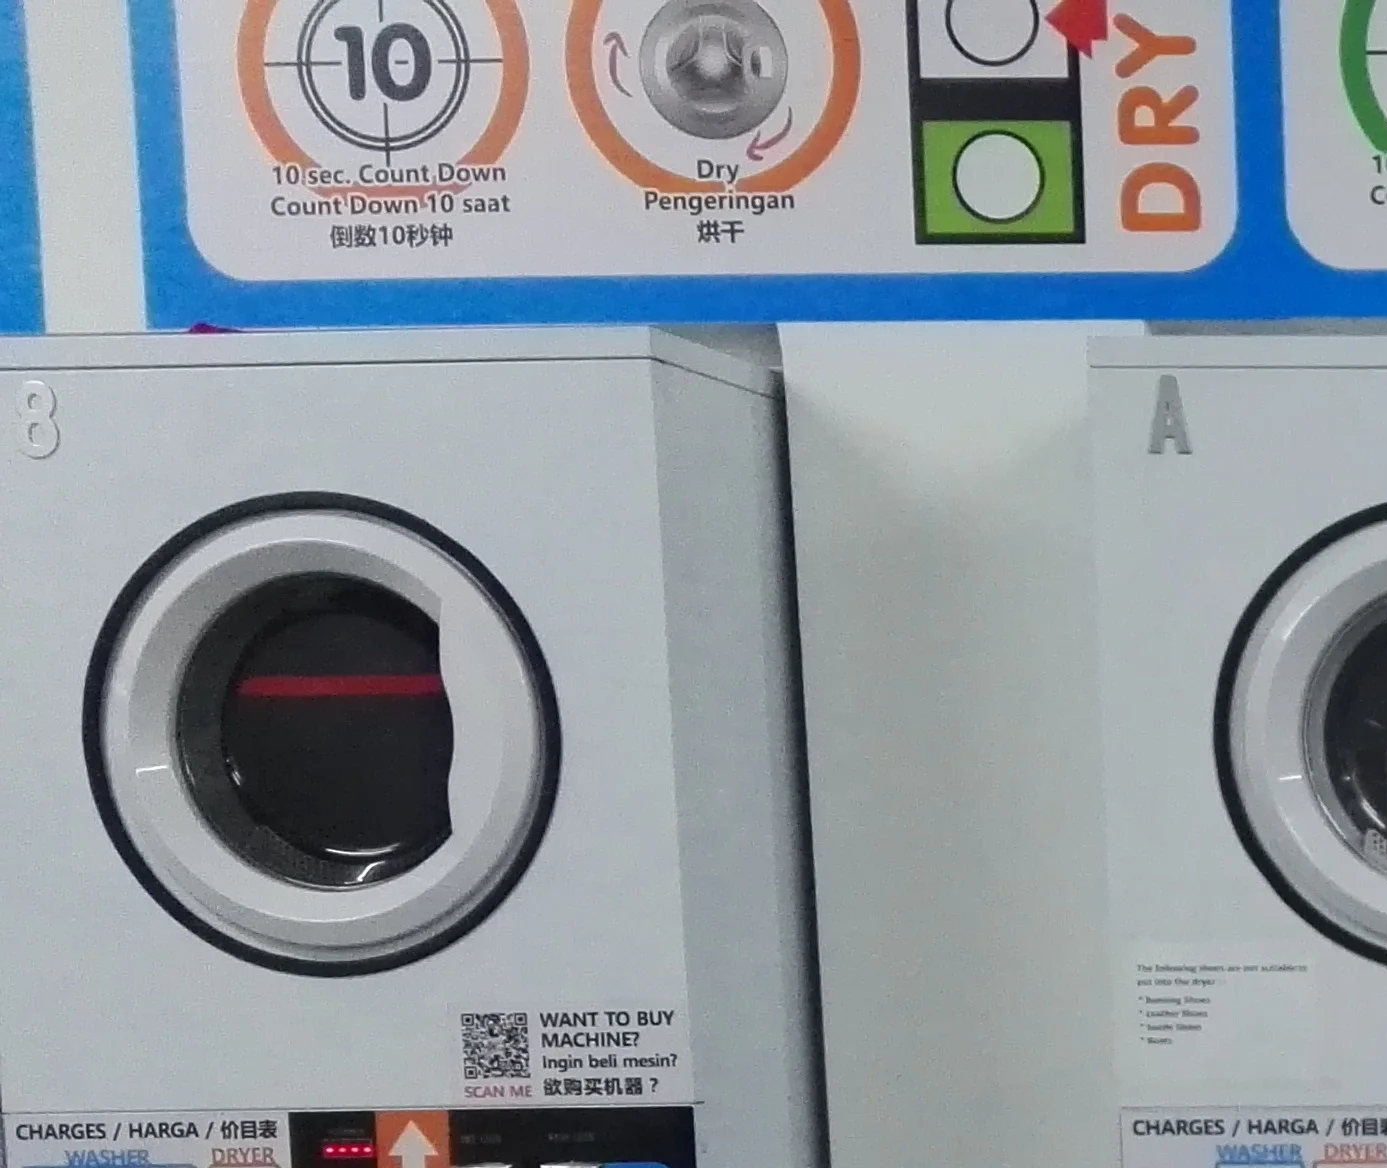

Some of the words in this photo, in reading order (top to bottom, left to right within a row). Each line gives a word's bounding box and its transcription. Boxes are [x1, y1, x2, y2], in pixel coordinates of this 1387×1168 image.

[334, 23, 432, 102] 10
[1112, 12, 1200, 232] DRY
[272, 165, 299, 186] 10
[308, 164, 352, 186] sec.
[358, 162, 430, 184] Count
[438, 161, 507, 183] Down
[697, 158, 739, 183] Dry
[271, 194, 342, 216] Count
[349, 194, 418, 215] Down
[426, 194, 455, 214] 10
[462, 193, 511, 214] saat
[644, 190, 796, 213] Pengeringan
[329, 224, 453, 249] 倒数10秒钟
[697, 219, 745, 244] 烘干
[17, 379, 60, 459] 8
[1147, 374, 1193, 455] A
[540, 1012, 598, 1027] WANT
[605, 1011, 630, 1026] TO
[637, 1010, 674, 1026] BUY
[541, 1033, 640, 1048] MACHINE?
[542, 1054, 583, 1071] Ingin
[588, 1053, 618, 1069] beli
[623, 1053, 678, 1069] mesin?
[464, 1086, 505, 1098] SCAN
[16, 1123, 106, 1140] CHARGES
[113, 1122, 122, 1141] /
[128, 1121, 199, 1139] HARGA
[205, 1121, 214, 1140] /
[220, 1119, 278, 1140] 价目表
[1132, 1118, 1225, 1136] CHARGES
[1231, 1119, 1240, 1138] /
[1247, 1118, 1319, 1136] HARGA
[1326, 1118, 1334, 1137] /
[65, 1149, 149, 1166] WASHER
[212, 1147, 274, 1165] DRYER
[1216, 1144, 1302, 1162] WASHER
[1323, 1142, 1387, 1160] DRYER
